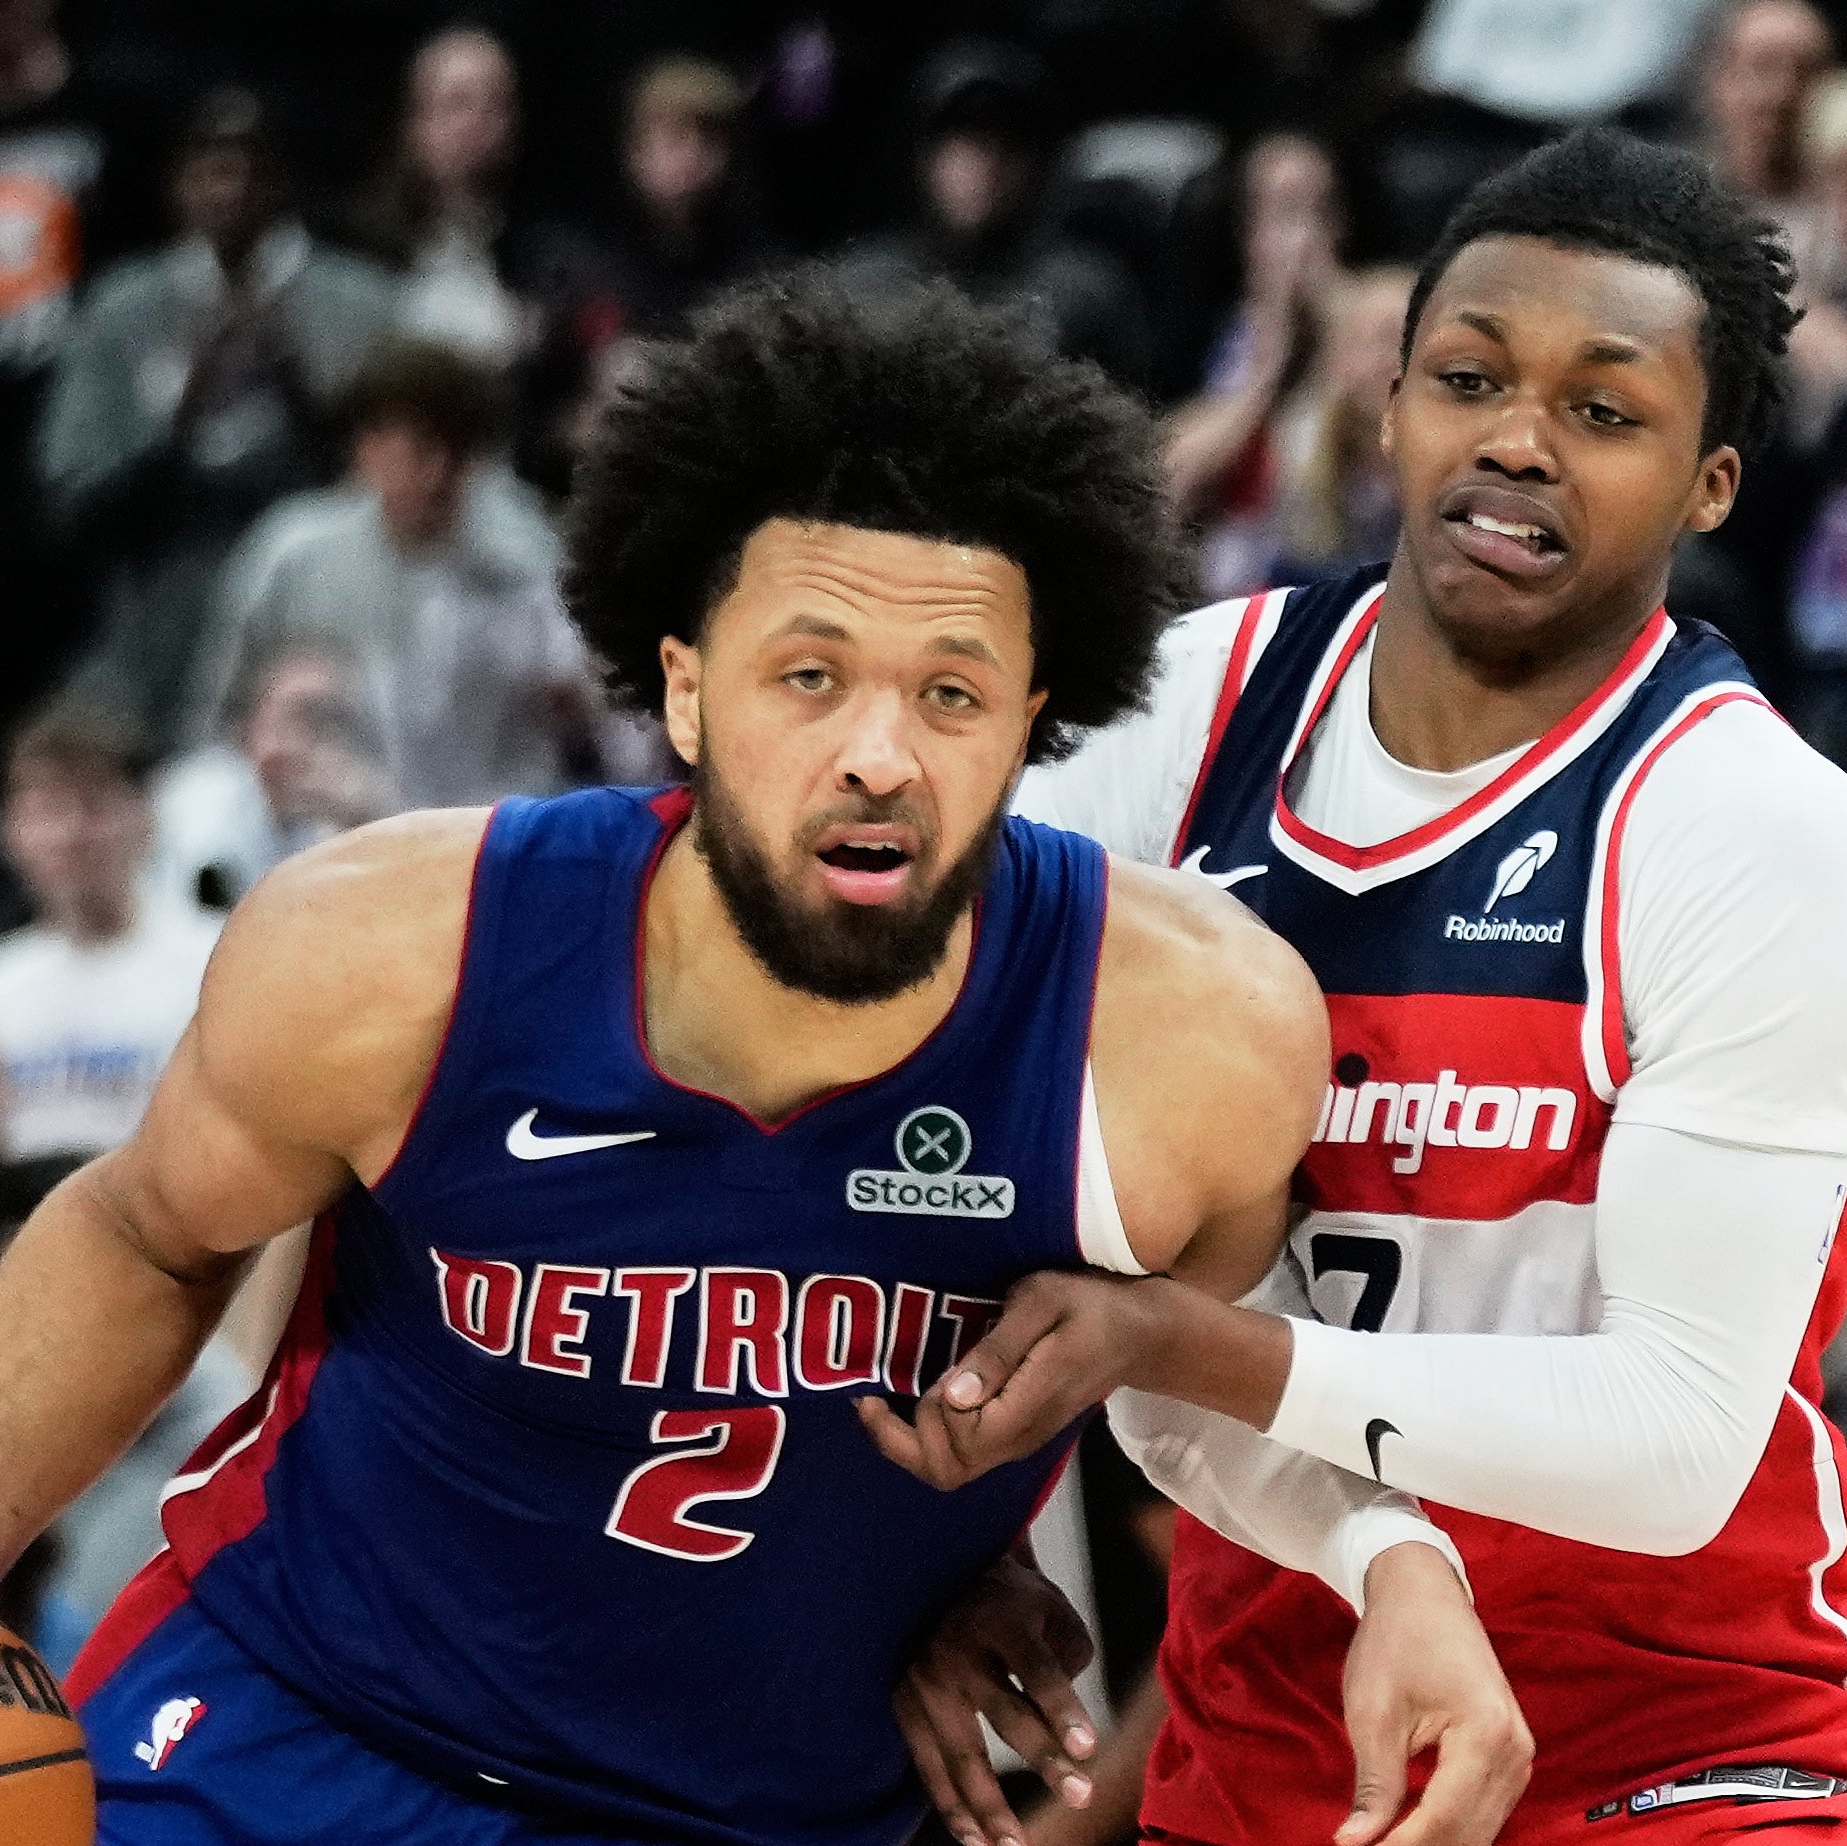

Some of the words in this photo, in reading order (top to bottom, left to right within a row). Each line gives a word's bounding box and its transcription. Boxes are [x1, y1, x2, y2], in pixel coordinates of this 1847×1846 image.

[1444, 915, 1566, 943] Robinhood
[854, 1176, 1007, 1212] StockX
[1310, 1232, 1403, 1334] 7
[605, 1403, 787, 1562] 2
